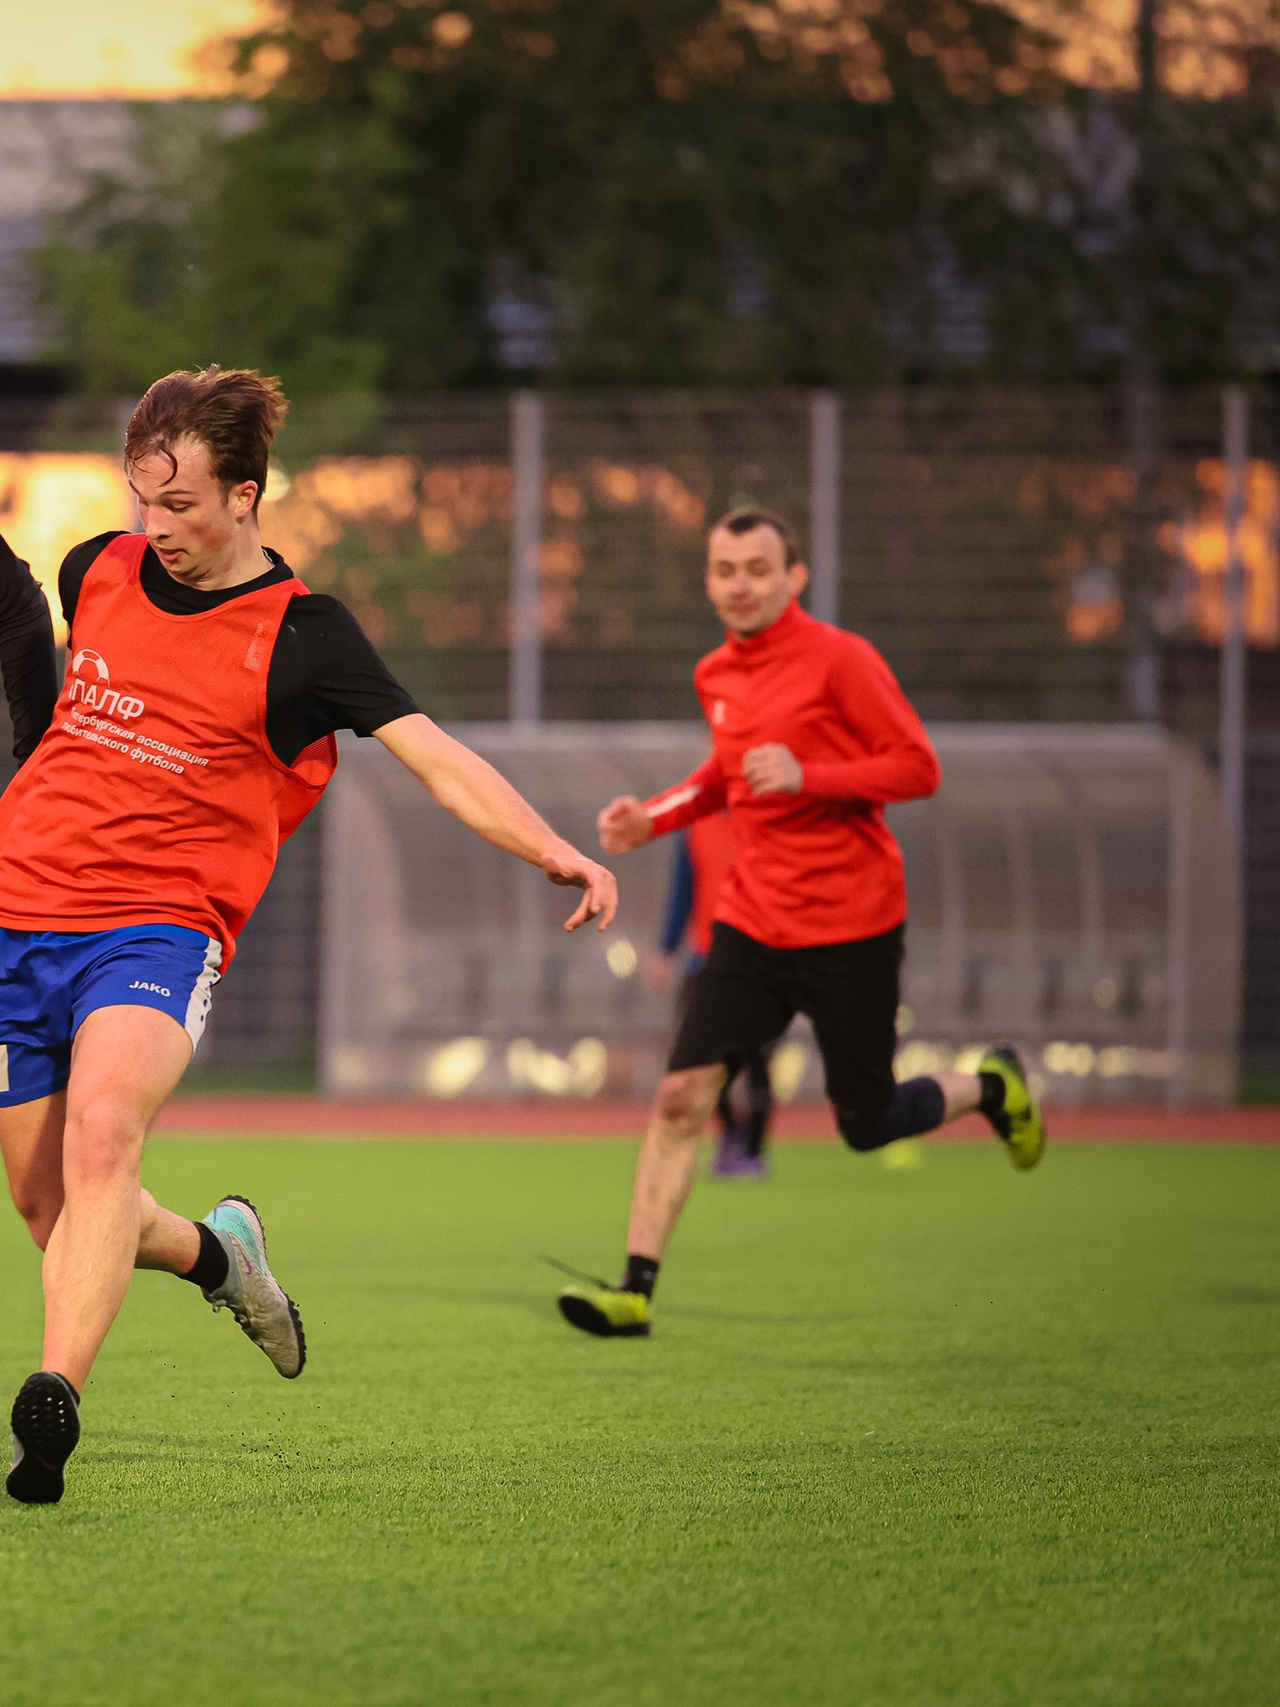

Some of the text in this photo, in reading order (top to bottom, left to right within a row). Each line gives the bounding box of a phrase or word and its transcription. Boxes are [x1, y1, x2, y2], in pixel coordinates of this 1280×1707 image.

[68, 678, 145, 721] ПАЛФ
[71, 707, 209, 766] тербургская ассоциация
[130, 747, 185, 774] футбола
[129, 980, 171, 997] JAKO
